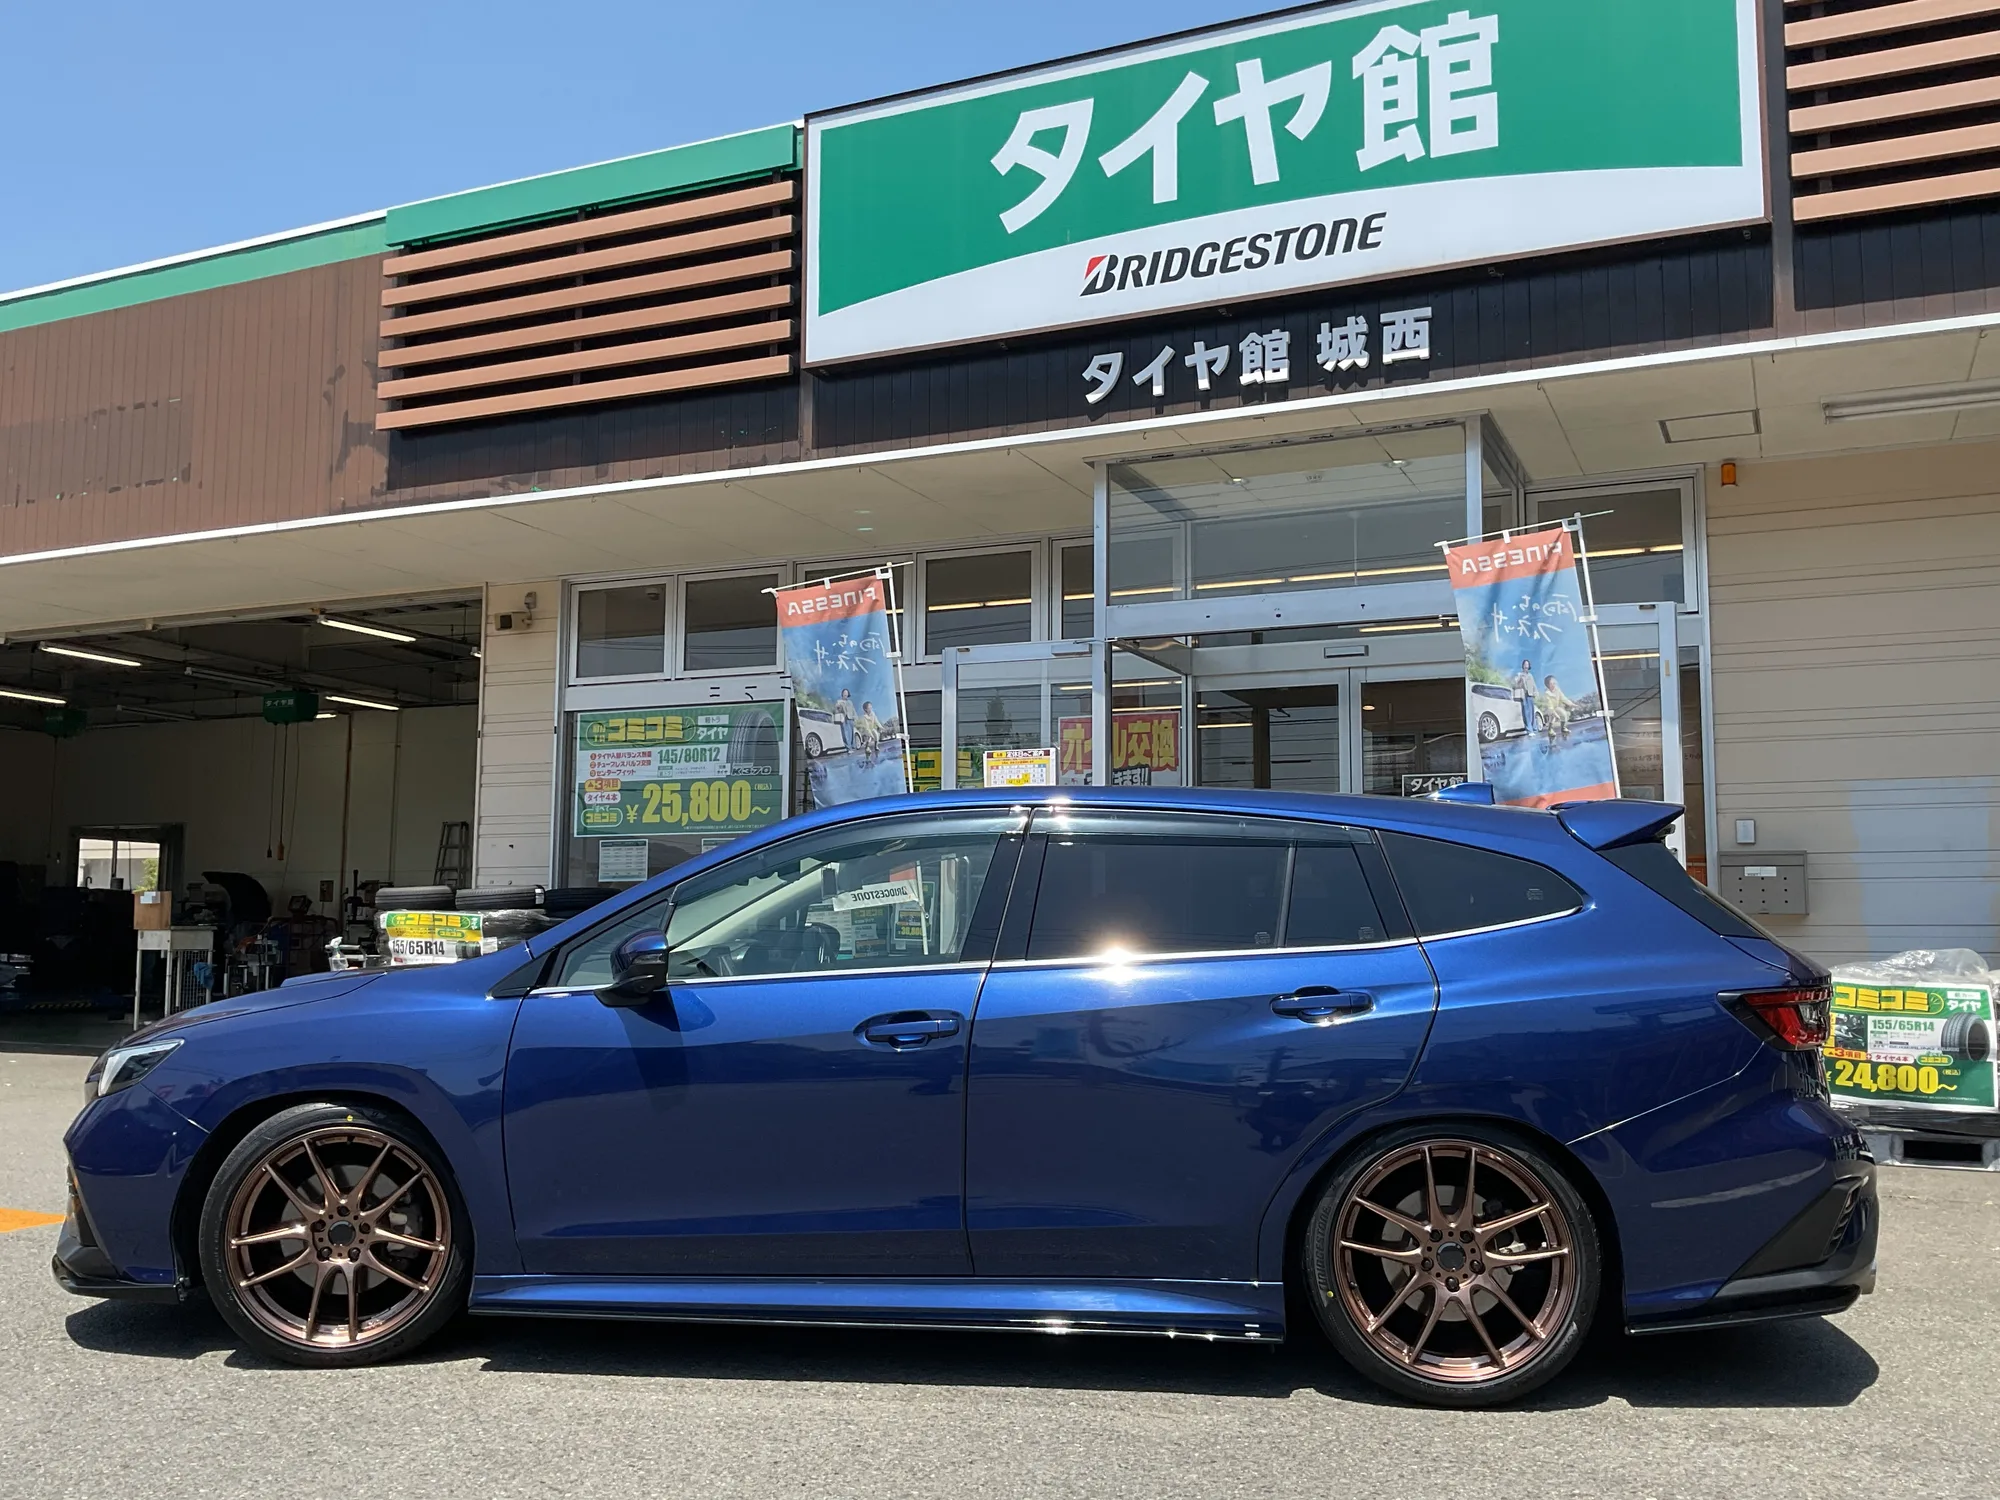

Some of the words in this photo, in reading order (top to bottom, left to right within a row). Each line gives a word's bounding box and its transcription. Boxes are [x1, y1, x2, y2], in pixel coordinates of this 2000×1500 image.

[990, 10, 1499, 233] タイヤ館
[1079, 212, 1387, 297] BRIDGESTONE
[1082, 329, 1291, 404] タイヤ館
[1316, 307, 1433, 373] 城西
[697, 727, 728, 740] タイヤ
[1063, 719, 1175, 770] オル交換
[657, 747, 720, 764] 145/80R12
[392, 940, 445, 955] 155/65R14
[1835, 986, 1929, 1011] コミコミ
[1947, 999, 1981, 1011] タイヤ
[1872, 1019, 1934, 1032] 155/65R14
